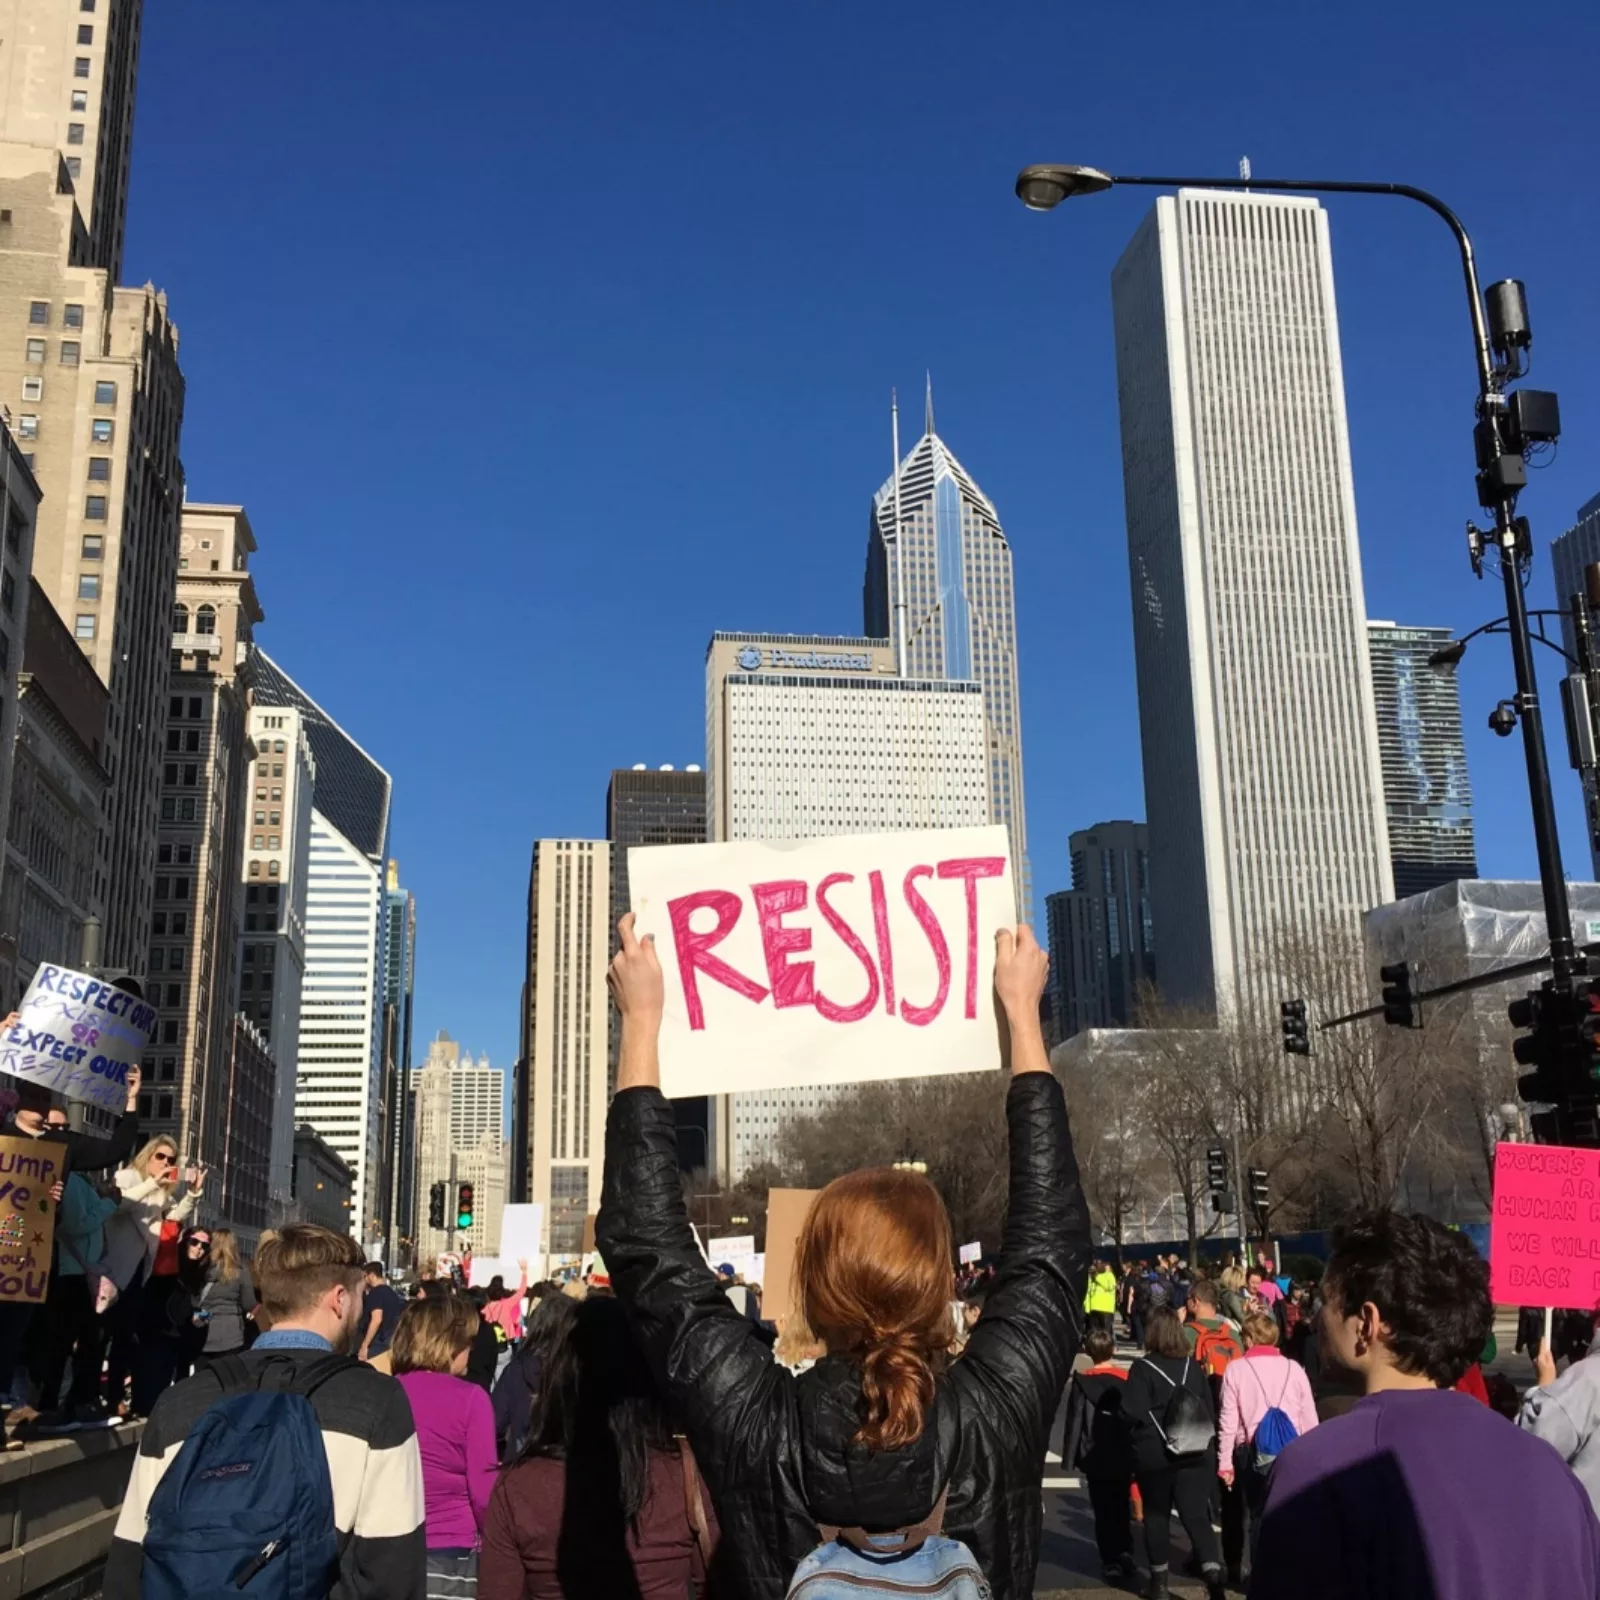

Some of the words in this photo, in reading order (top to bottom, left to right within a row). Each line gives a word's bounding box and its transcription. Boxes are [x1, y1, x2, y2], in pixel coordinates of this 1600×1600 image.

[666, 856, 1007, 1031] RESIST
[37, 966, 134, 1017] RESPECT
[130, 1004, 156, 1034] OUR
[71, 1023, 100, 1048] OR
[8, 1022, 88, 1065] EXPECT
[90, 1055, 130, 1086] OUR
[1498, 1151, 1585, 1176] WOMEN'S
[1562, 1178, 1600, 1199] AR
[1498, 1196, 1577, 1221] HUMAN
[1507, 1232, 1541, 1255] WE
[1552, 1237, 1600, 1261] WILL
[1509, 1265, 1571, 1288] BACK
